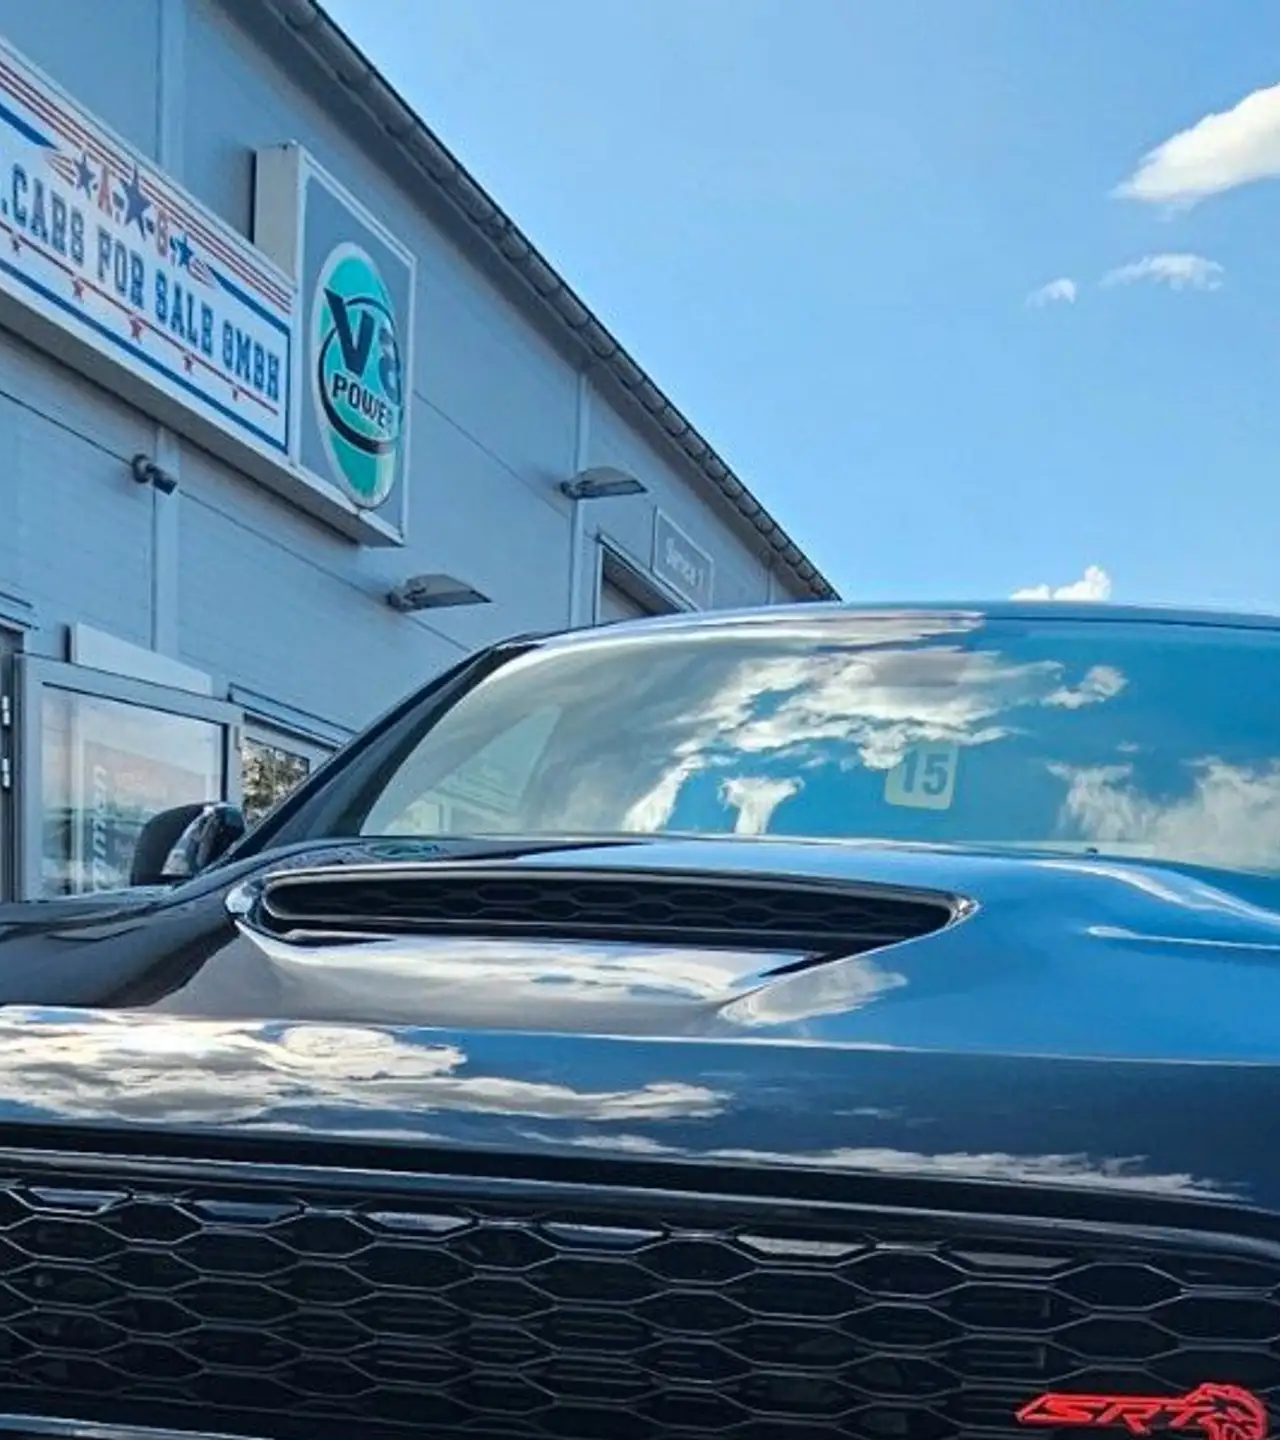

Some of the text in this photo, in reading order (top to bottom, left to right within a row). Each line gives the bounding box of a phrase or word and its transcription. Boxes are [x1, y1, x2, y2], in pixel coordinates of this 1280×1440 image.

[97, 224, 144, 310] FOR
[155, 268, 214, 358] SALE
[222, 319, 280, 402] GMBH
[901, 750, 950, 796] 15
[1015, 1393, 1213, 1436] SRT
